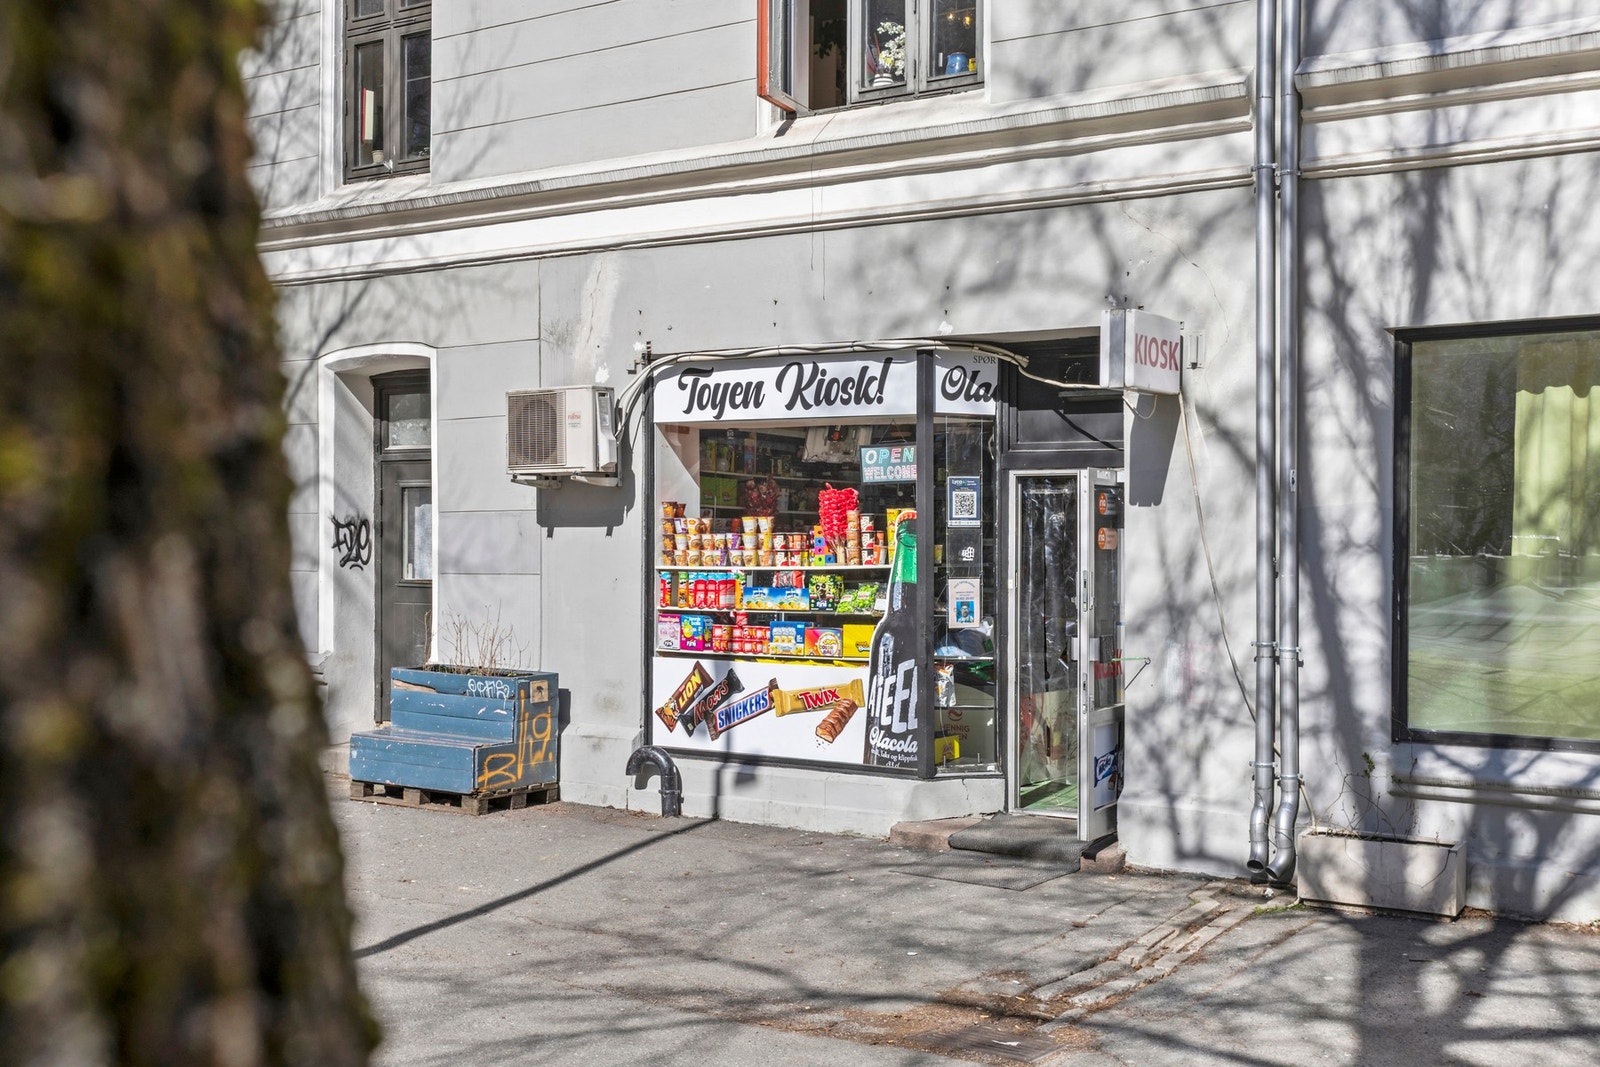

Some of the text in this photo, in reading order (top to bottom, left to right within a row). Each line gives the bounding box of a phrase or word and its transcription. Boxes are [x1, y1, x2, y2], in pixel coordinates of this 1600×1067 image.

[1135, 333, 1179, 371] KIOSK
[775, 357, 894, 411] Kiosk!
[863, 464, 918, 480] WELCOME
[865, 447, 915, 465] OPEN
[678, 668, 702, 709] LION
[693, 679, 729, 726] Mars
[717, 690, 769, 729] SNICKERS
